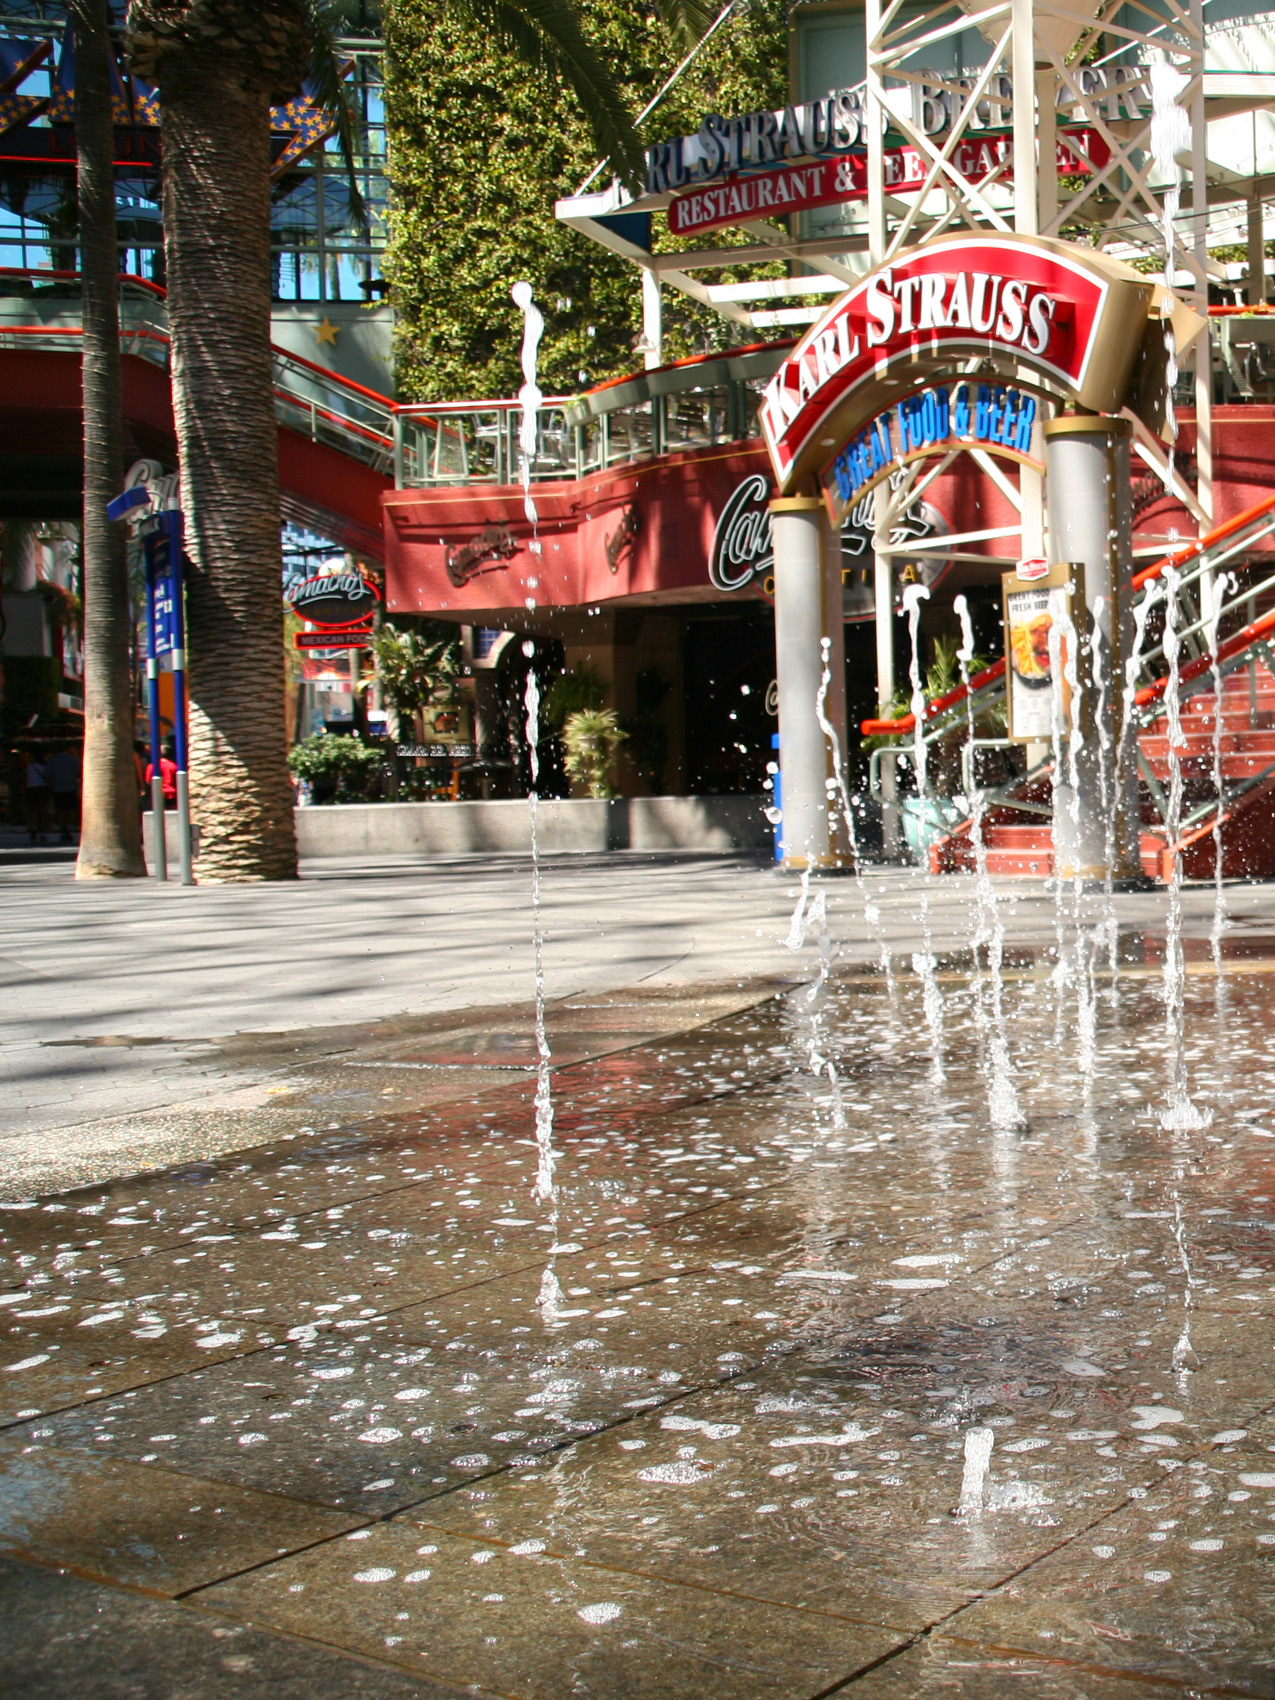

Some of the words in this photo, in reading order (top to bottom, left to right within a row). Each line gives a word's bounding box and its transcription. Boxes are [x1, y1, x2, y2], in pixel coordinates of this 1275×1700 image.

[677, 166, 826, 229] RESTAURANT
[834, 161, 856, 192] &
[765, 312, 860, 440] KARL
[866, 267, 1055, 355] STRAUSS
[834, 411, 893, 501] GREAT
[898, 388, 950, 452] FOOD
[955, 385, 970, 438] &
[975, 385, 1036, 453] BEER
[302, 636, 344, 645] MEXICAN
[346, 635, 369, 643] FOO
